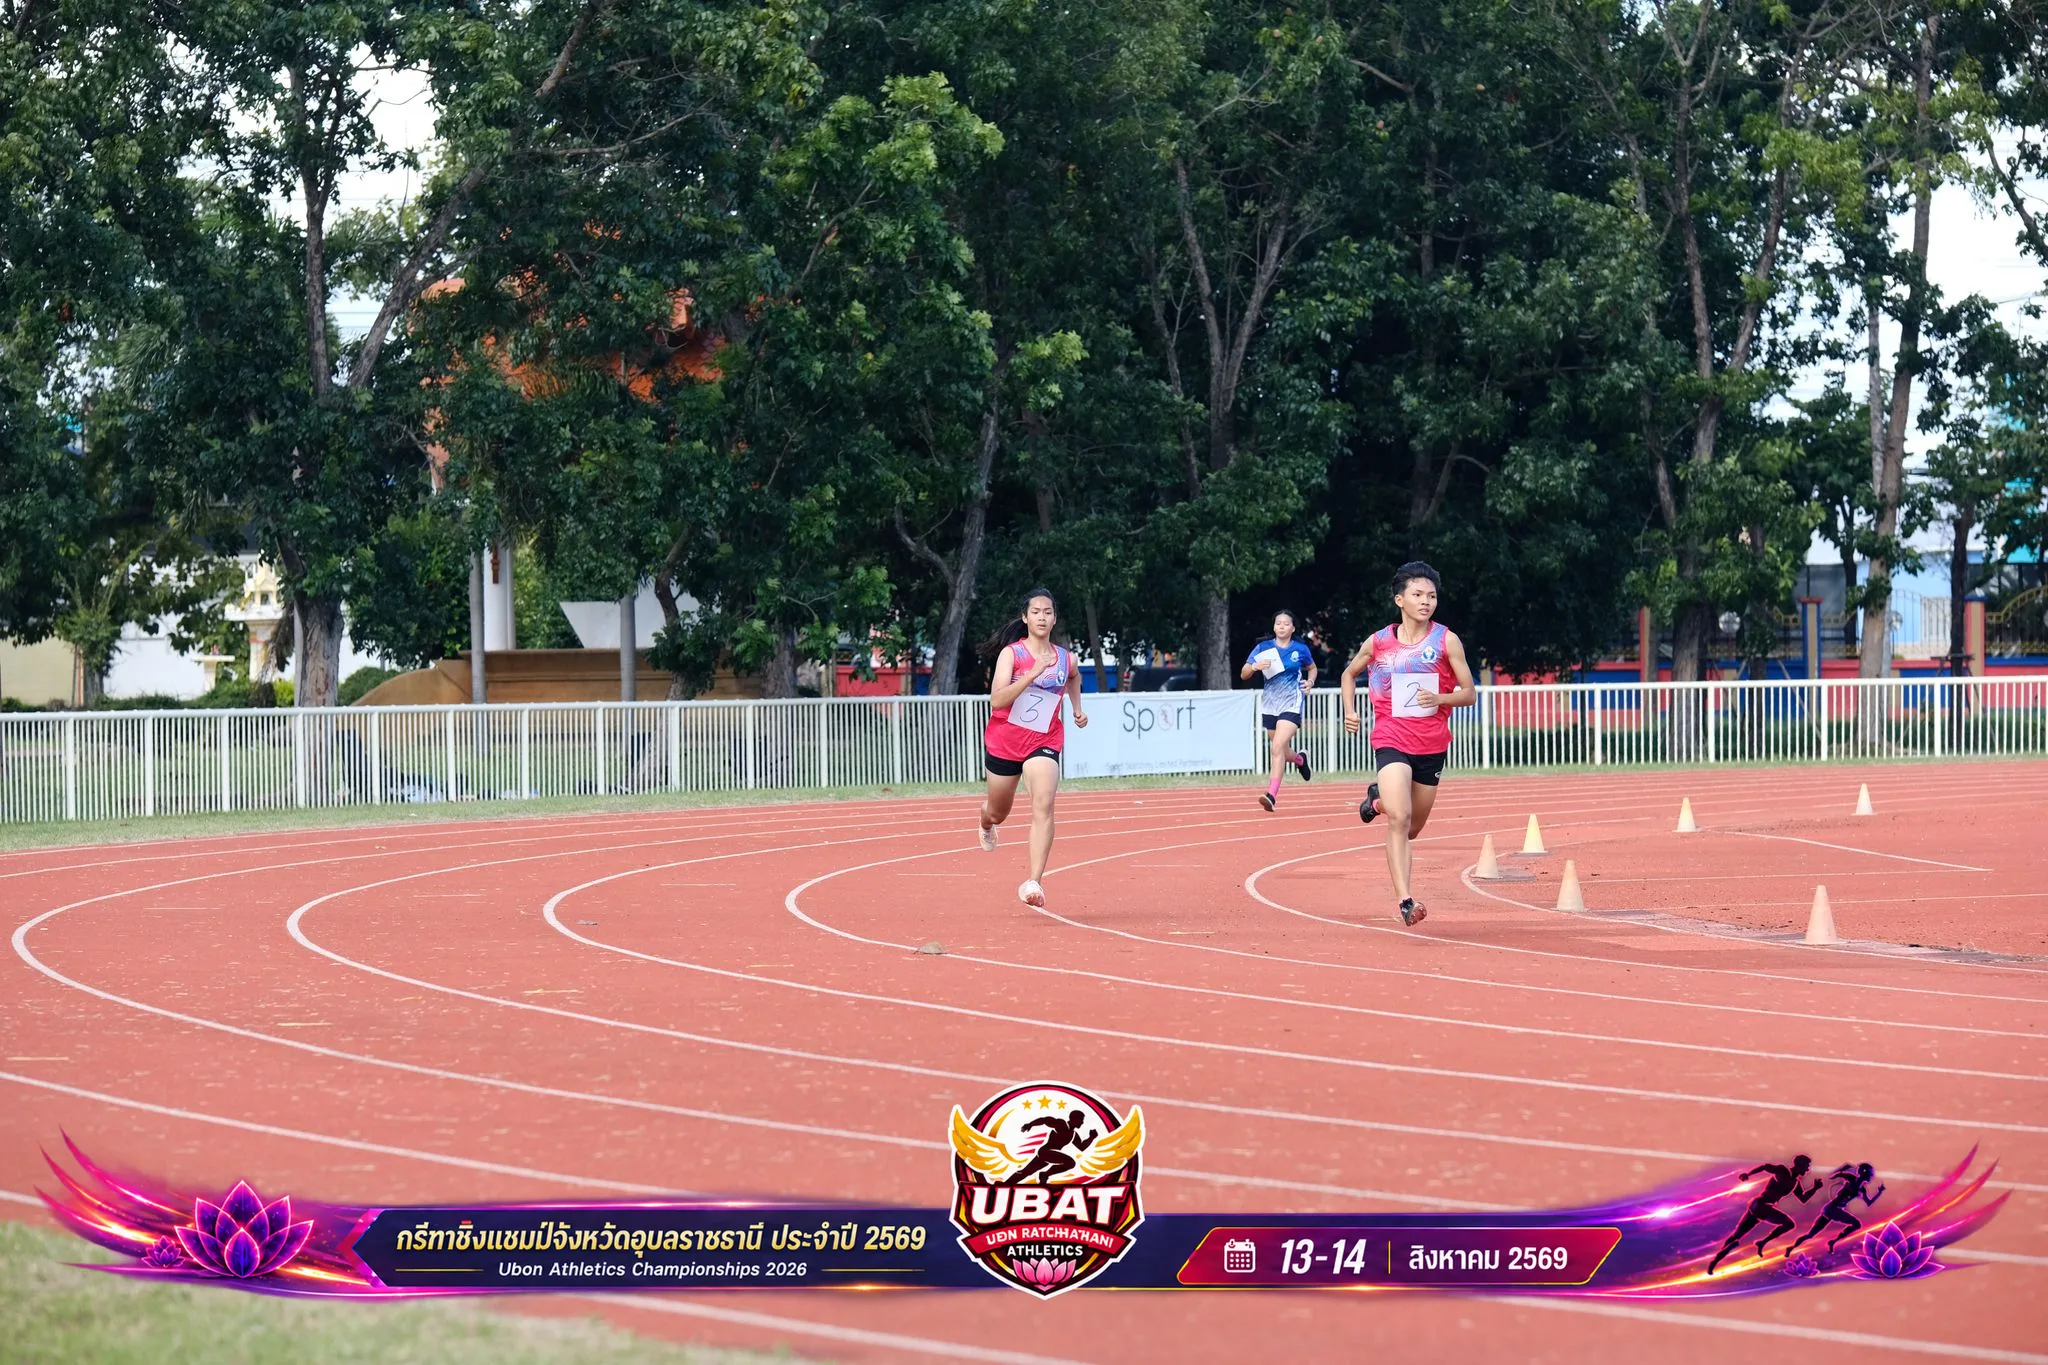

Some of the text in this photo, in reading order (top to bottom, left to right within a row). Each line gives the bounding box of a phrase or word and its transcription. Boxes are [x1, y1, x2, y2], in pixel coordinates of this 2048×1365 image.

[1019, 693, 1044, 723] 3
[1403, 681, 1422, 708] 2
[1122, 699, 1196, 739] Sport
